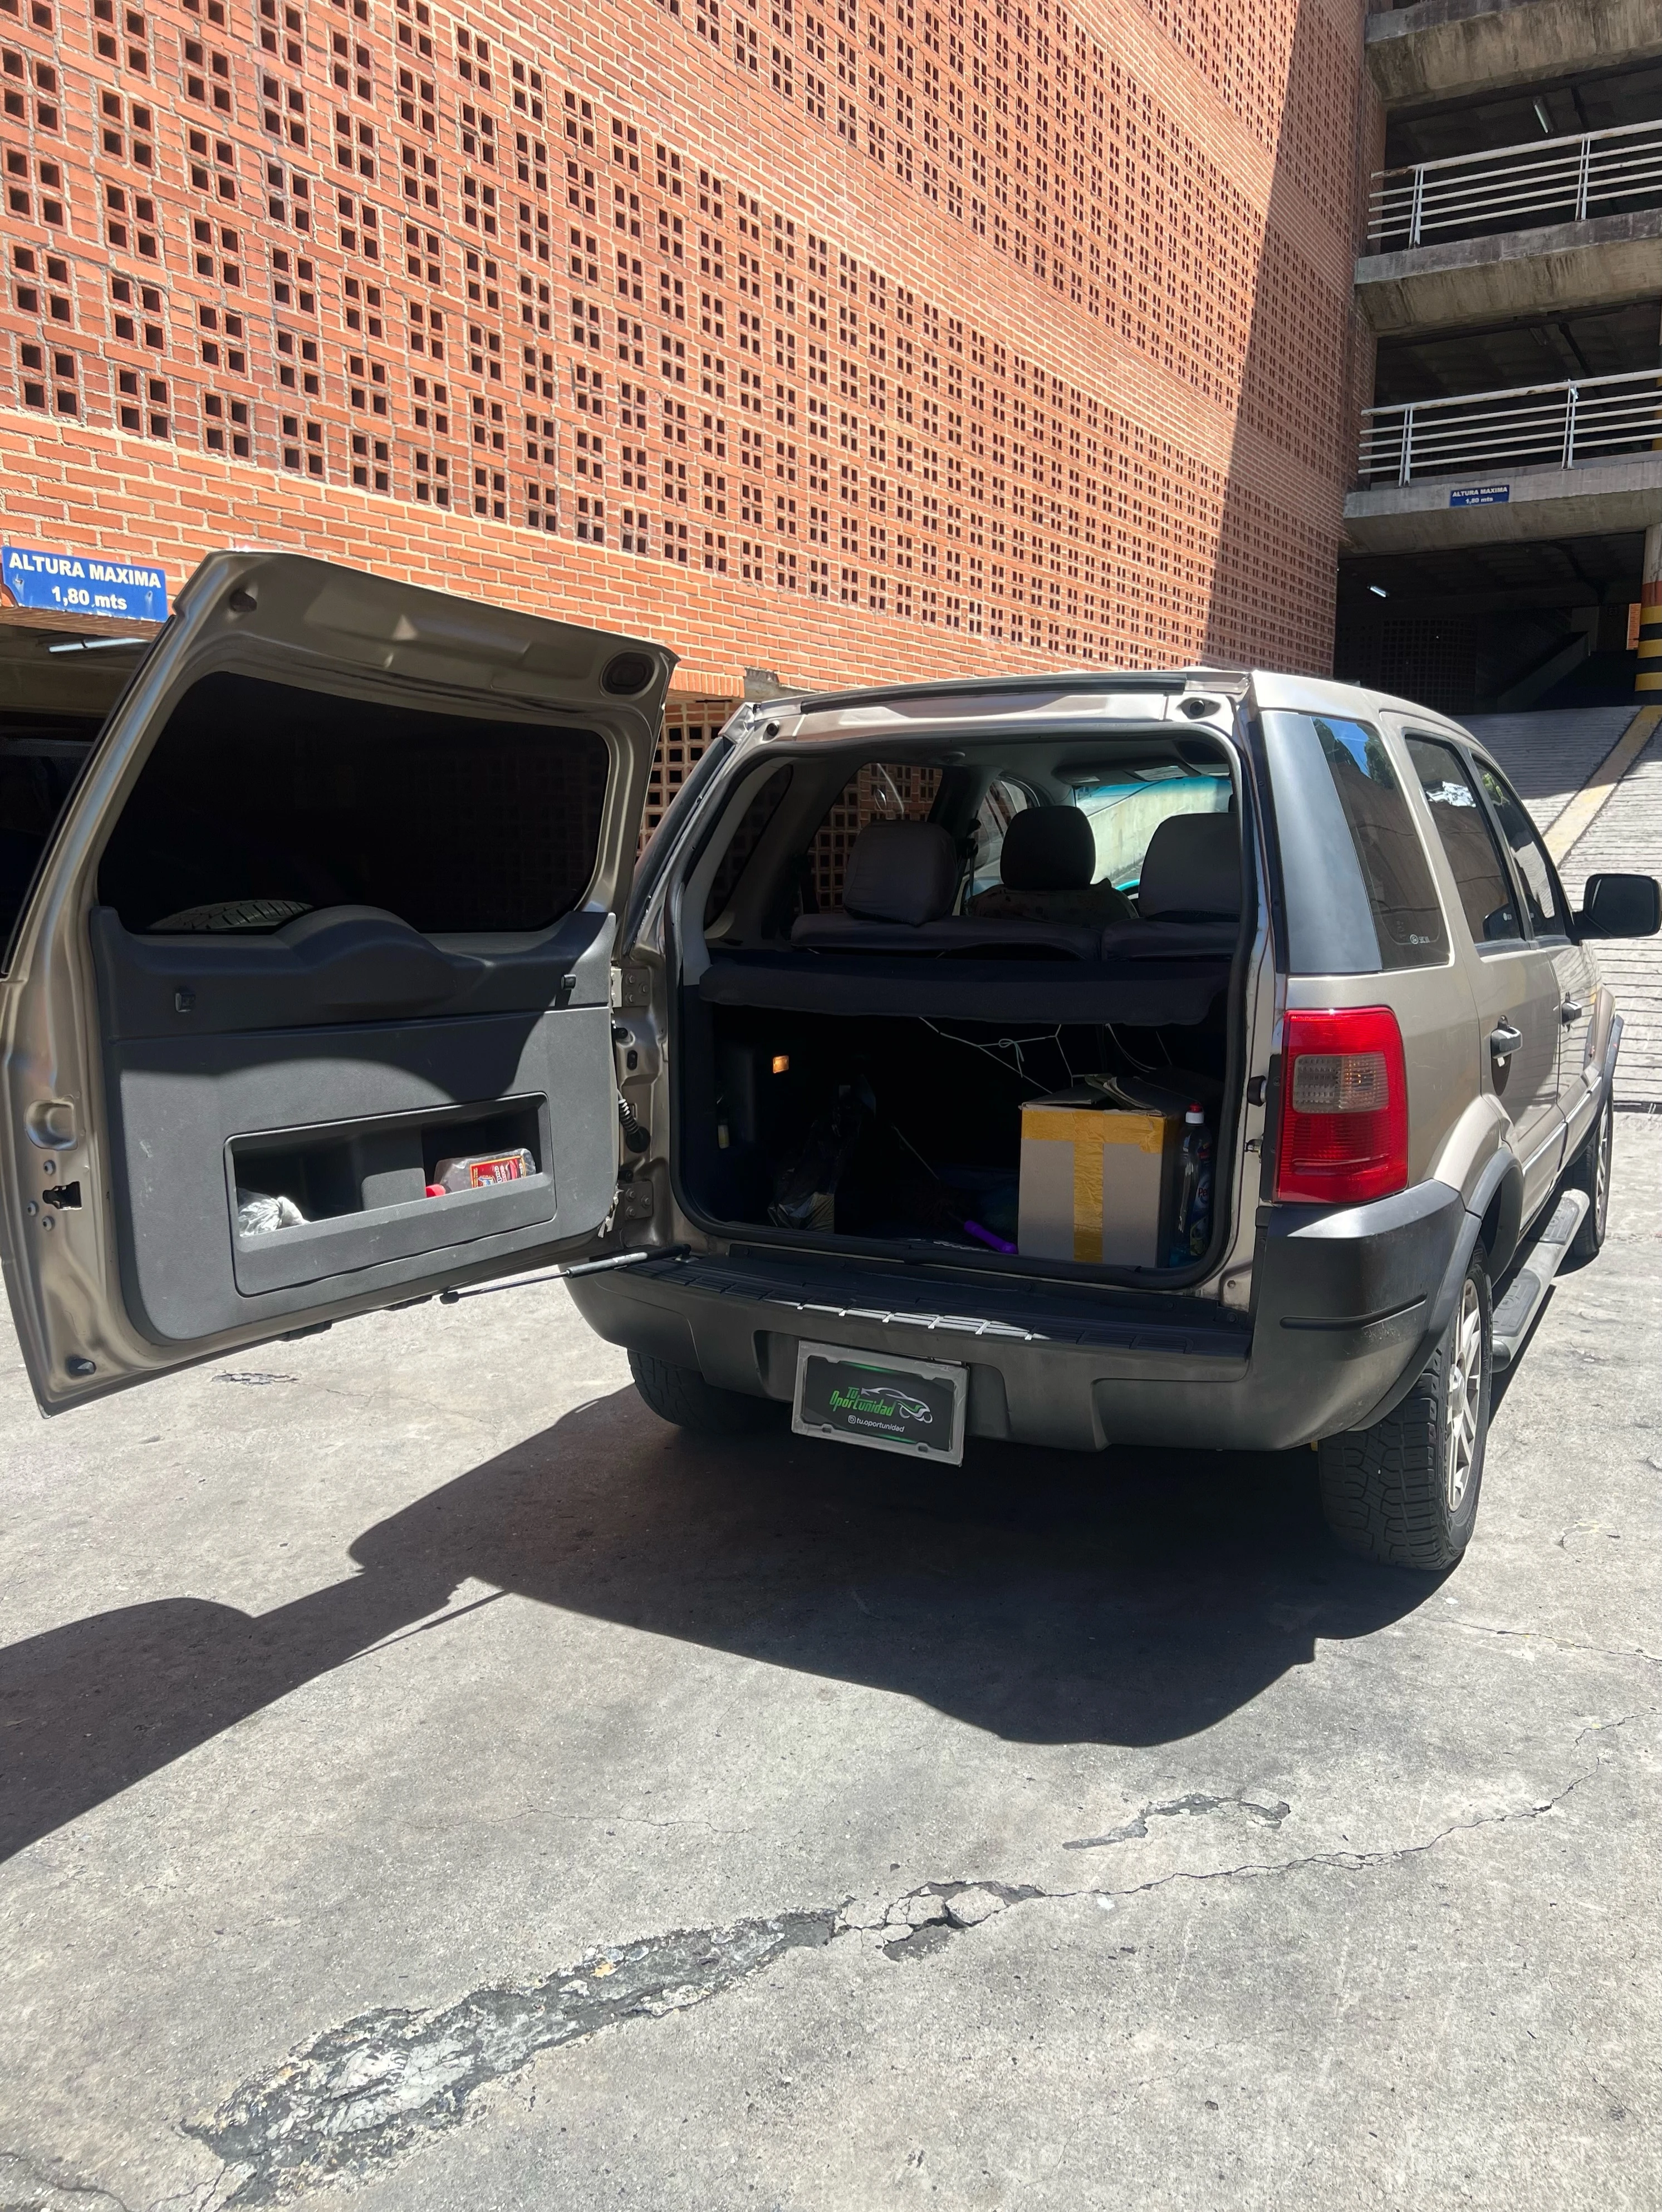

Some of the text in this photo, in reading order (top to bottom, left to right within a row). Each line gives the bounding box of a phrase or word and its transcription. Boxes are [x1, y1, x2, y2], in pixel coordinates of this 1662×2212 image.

[9, 553, 161, 588] ALTURA MAXIMA
[52, 586, 128, 610] 1,80 mts
[829, 1390, 897, 1416] Oportunidad
